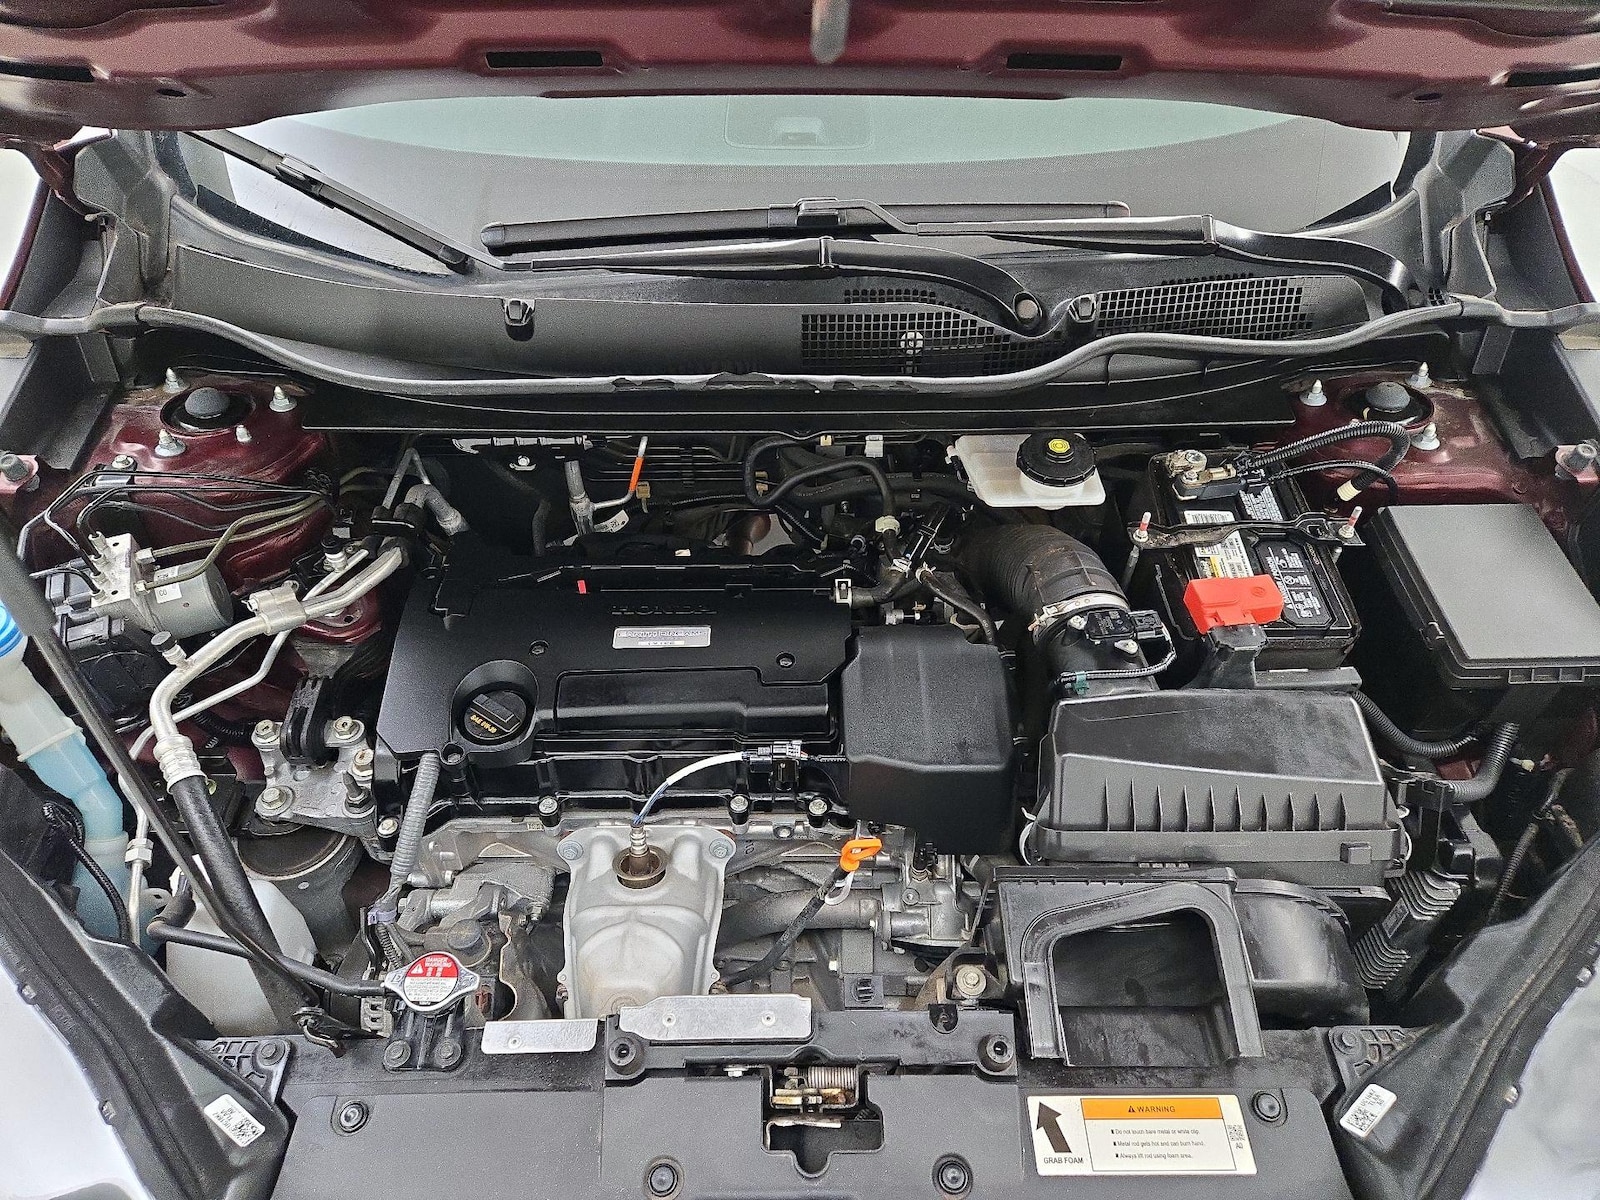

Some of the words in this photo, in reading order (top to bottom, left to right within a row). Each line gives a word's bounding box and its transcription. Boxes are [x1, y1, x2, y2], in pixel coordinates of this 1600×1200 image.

[1265, 556, 1280, 577] POISON
[1136, 1105, 1176, 1113] WARNING
[1043, 1156, 1063, 1164] GRAB
[1064, 1156, 1084, 1164] FOAM
[1120, 1152, 1137, 1160] Always
